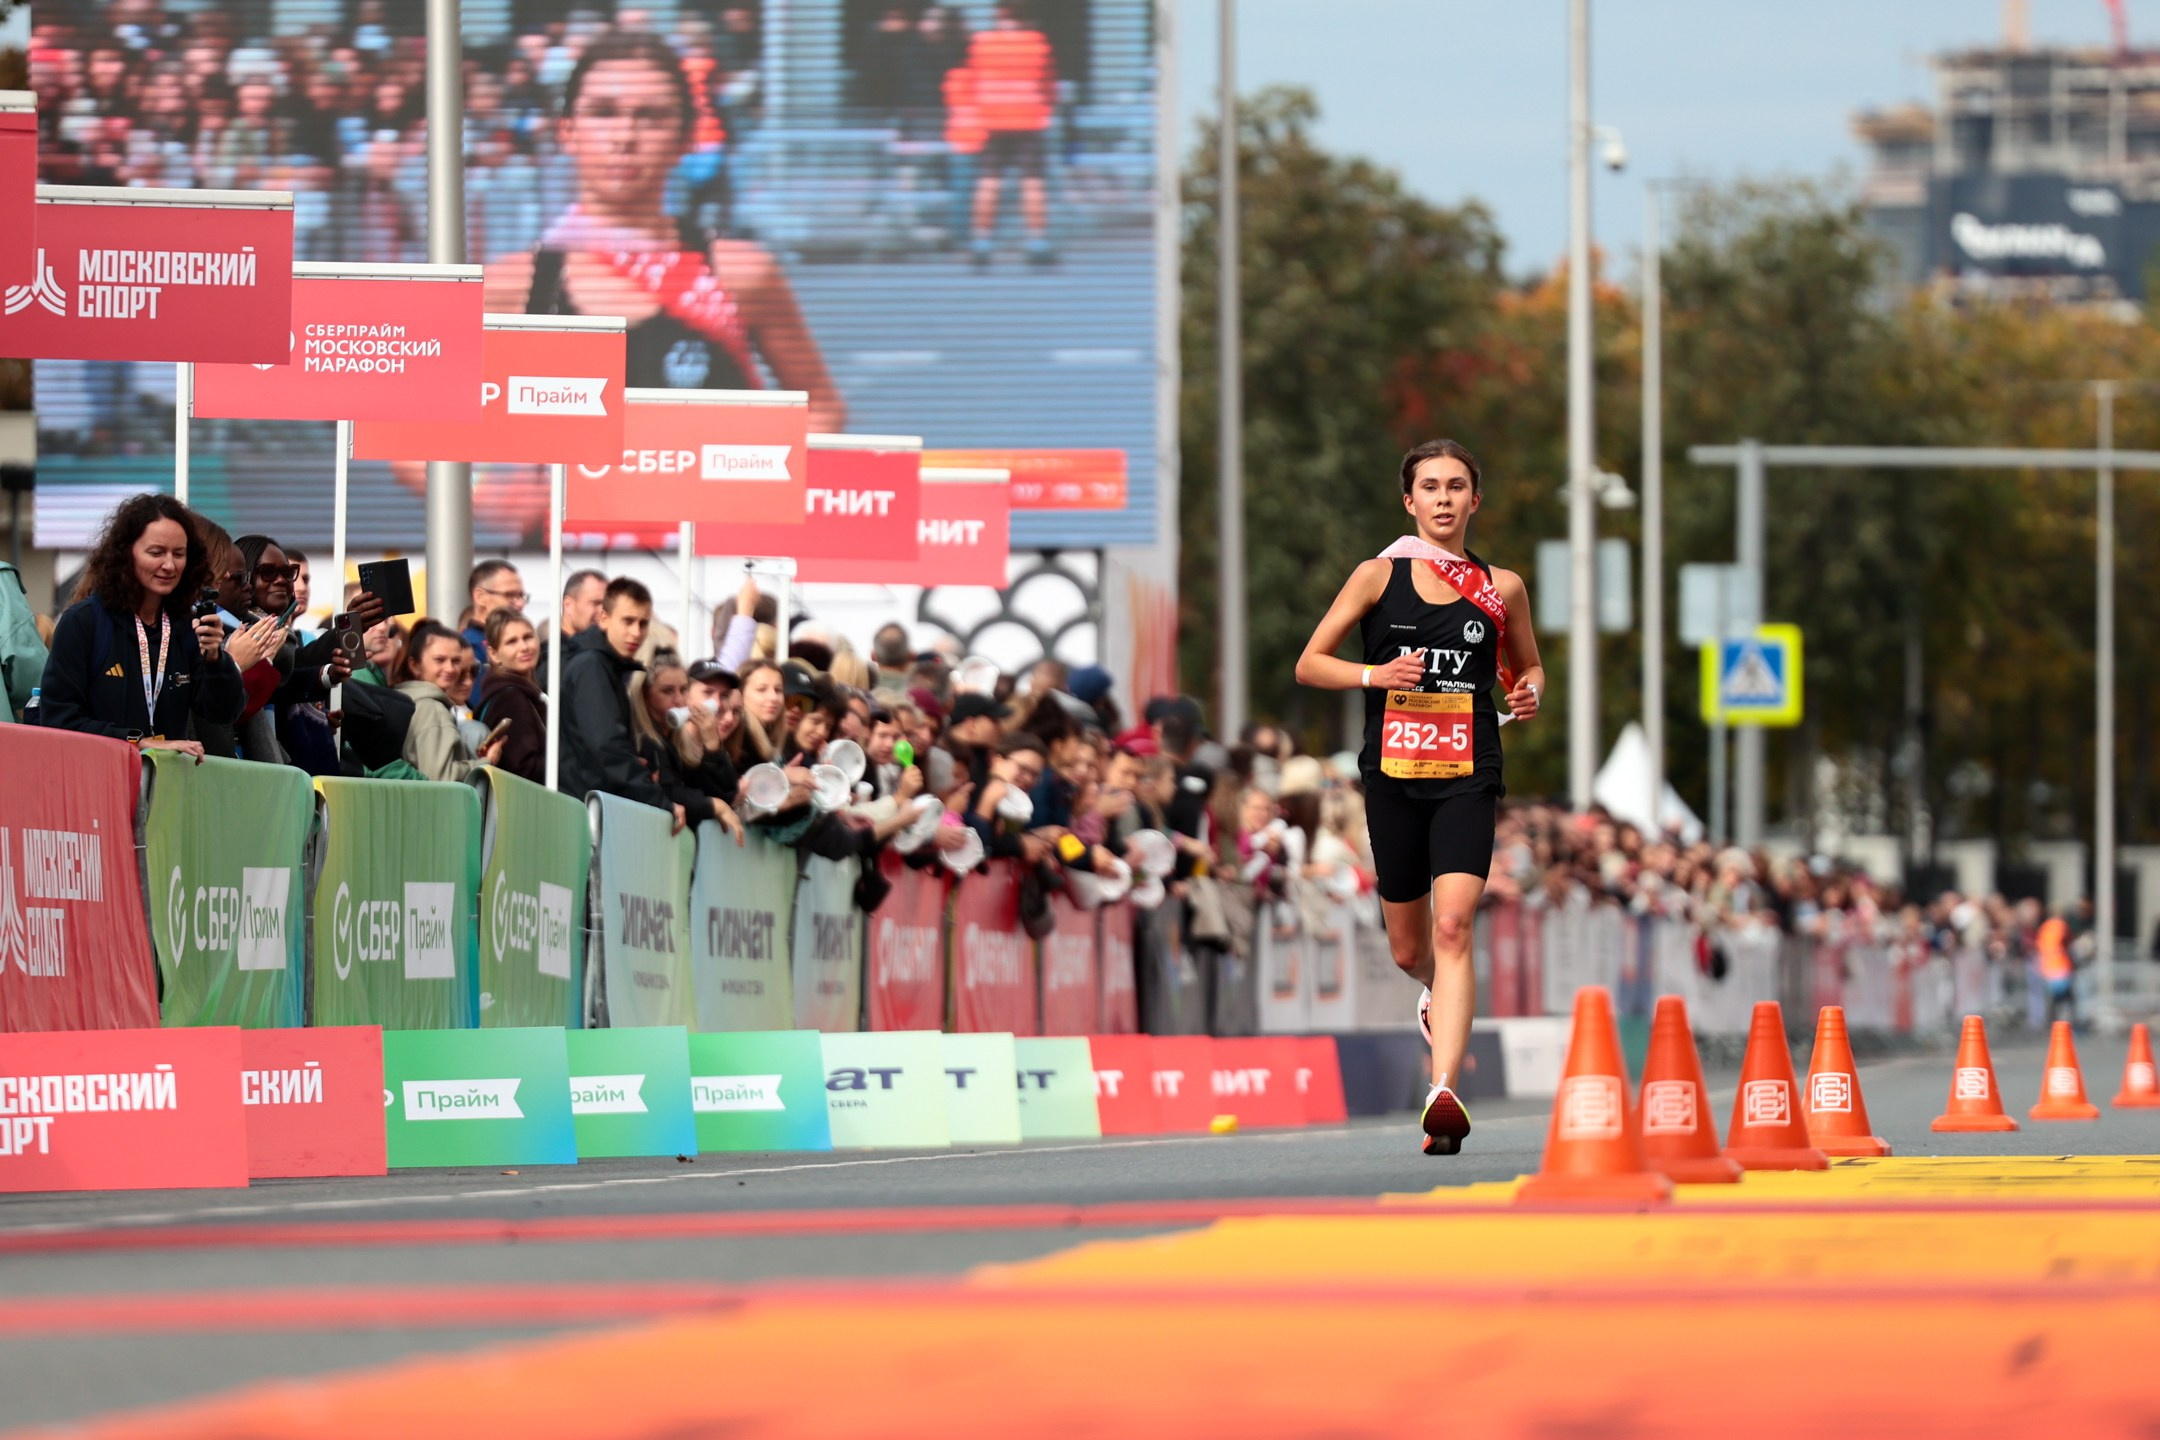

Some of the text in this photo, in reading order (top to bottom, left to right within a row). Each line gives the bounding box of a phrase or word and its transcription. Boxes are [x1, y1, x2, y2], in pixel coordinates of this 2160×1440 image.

[79, 246, 256, 286] МОСКОВСКИЙ
[78, 284, 162, 319] СПОРТ
[305, 324, 405, 338] СБЕРПРАЙМ
[304, 338, 441, 357] МОСКОВСКИЙ
[304, 356, 405, 373] МАРАФОН
[519, 386, 588, 405] Прайм
[620, 449, 774, 473] СБЕР Прайм
[1436, 680, 1476, 690] УРАЛХИМ
[1387, 721, 1468, 751] 252-5
[194, 885, 239, 951] СБЕР
[357, 900, 446, 961] СБЕР Прайм
[241, 1061, 323, 1105] СКИЙ
[694, 1083, 764, 1104] Прайм
[417, 1088, 499, 1112] Прайм
